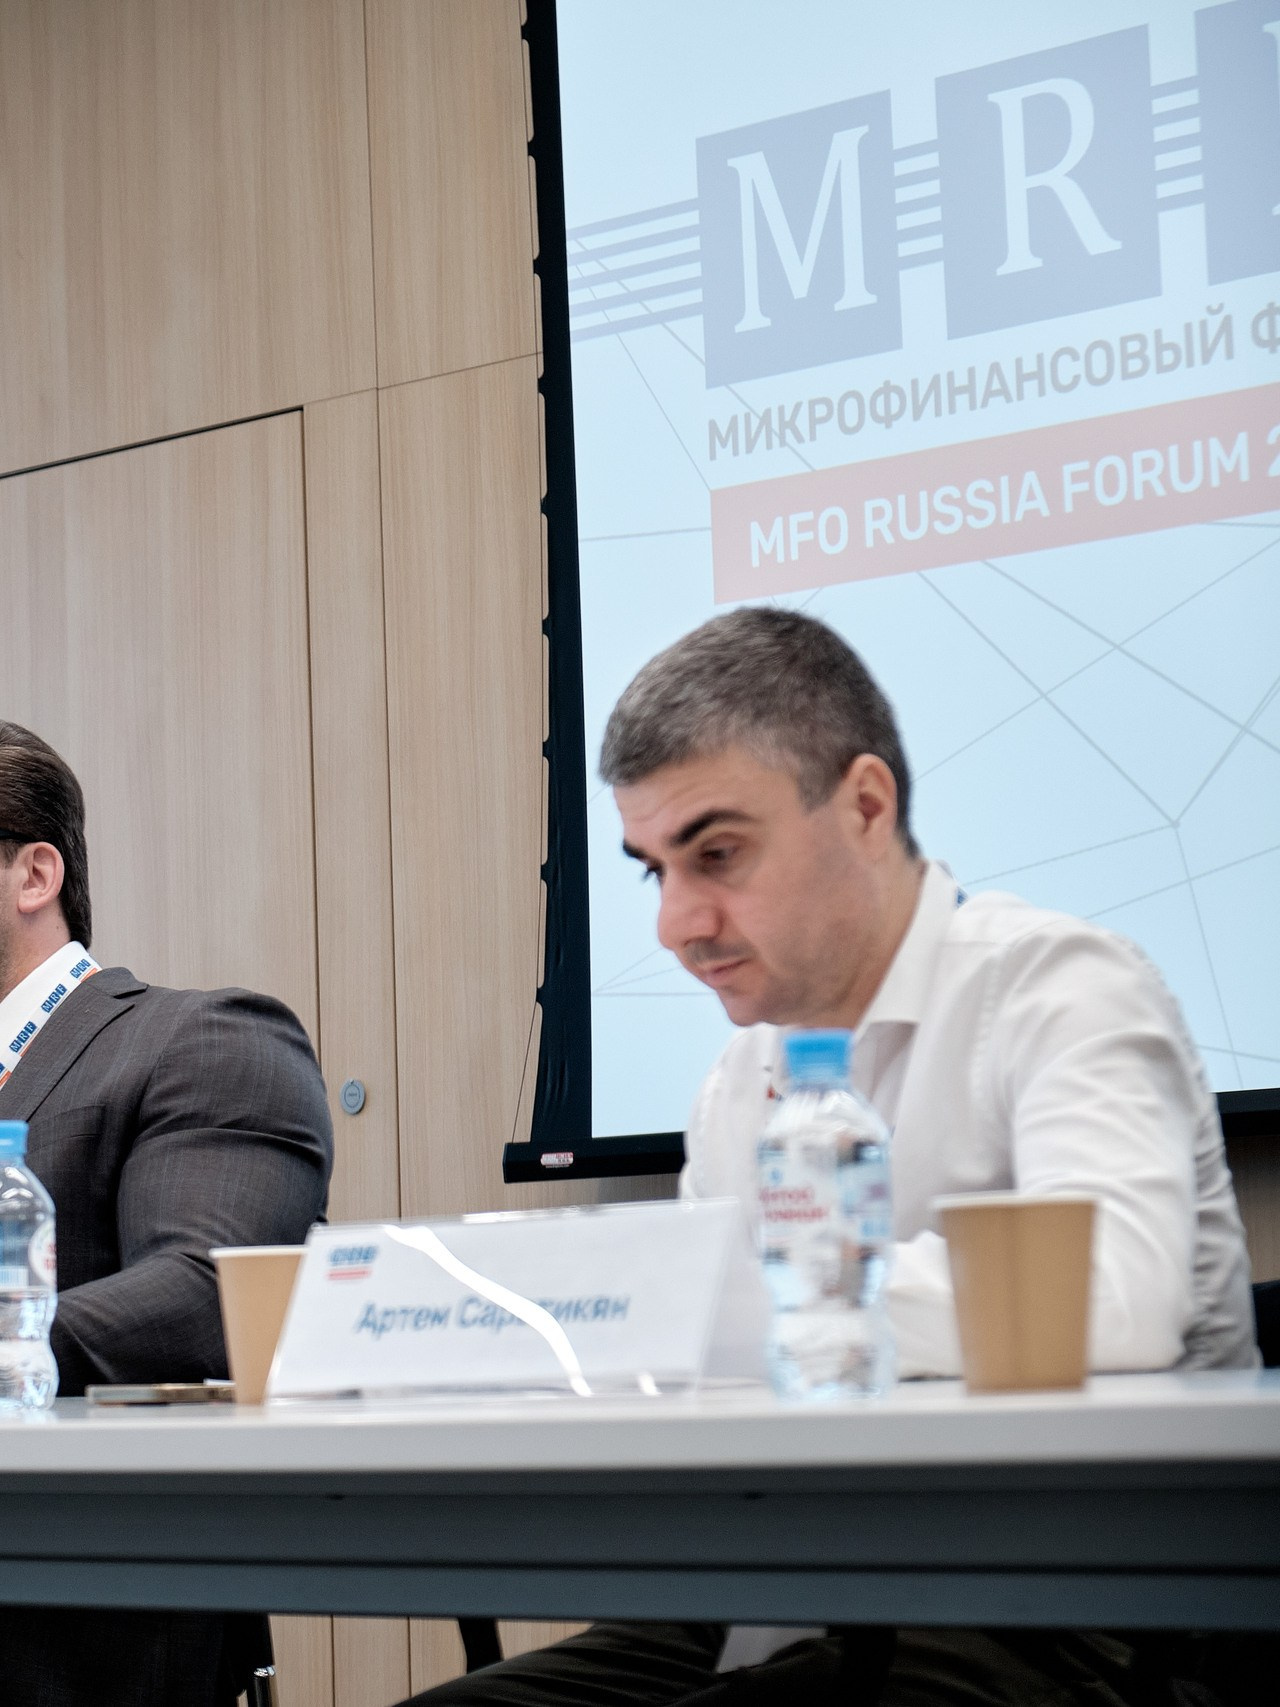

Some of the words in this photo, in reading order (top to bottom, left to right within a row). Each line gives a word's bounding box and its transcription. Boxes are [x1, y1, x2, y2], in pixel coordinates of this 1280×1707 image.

[707, 302, 1235, 462] МИКРОФИНАНСОВЫЙ
[749, 505, 849, 568] MFO
[863, 469, 1050, 548] RUSSIA
[1061, 431, 1250, 514] FORUM
[40, 983, 68, 1013] MRF
[9, 1021, 37, 1053] MRF
[353, 1302, 451, 1342] Артем
